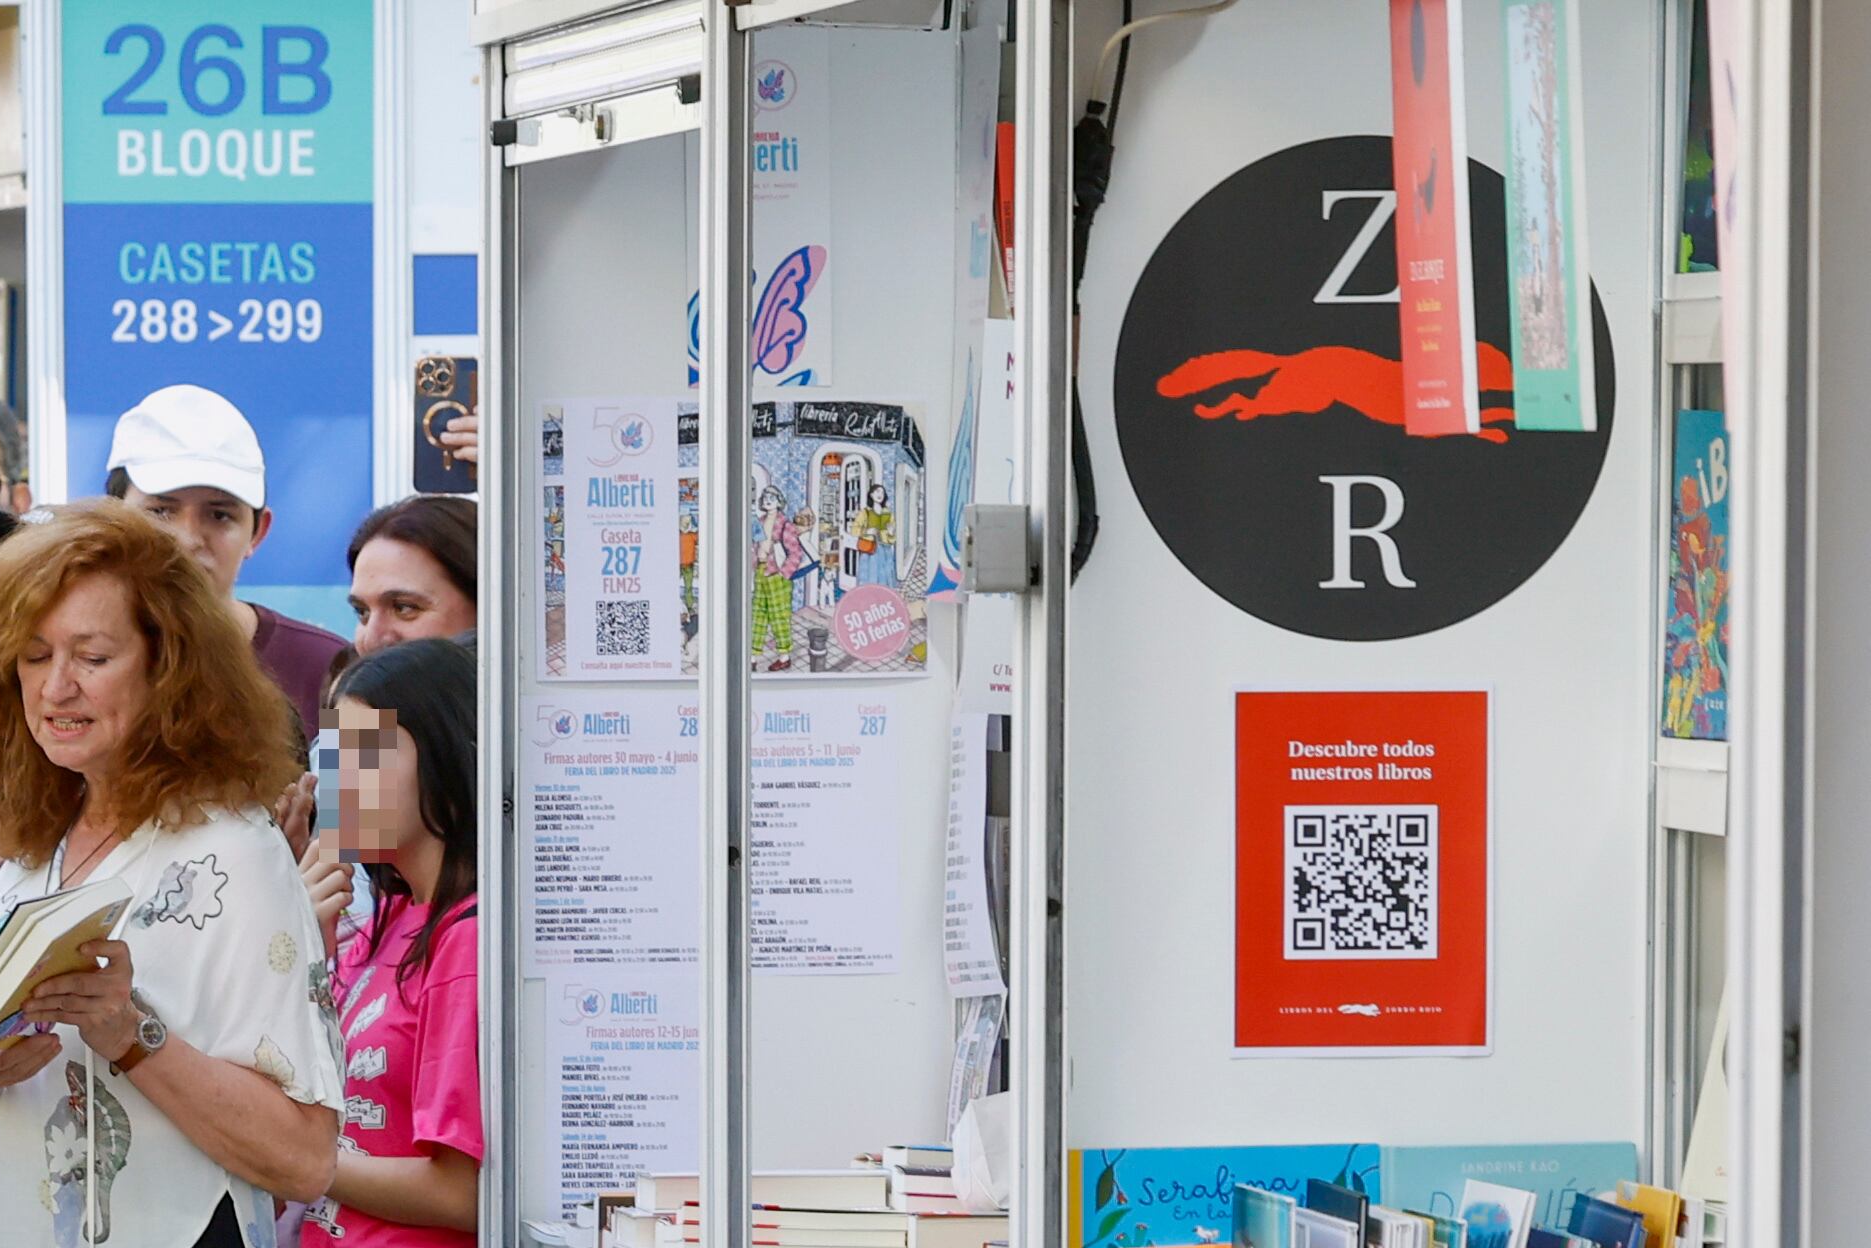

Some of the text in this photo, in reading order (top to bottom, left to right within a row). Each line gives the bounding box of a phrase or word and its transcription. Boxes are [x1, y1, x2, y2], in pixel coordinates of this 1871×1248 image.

[102, 24, 333, 117] 26B
[117, 130, 315, 179] BLOQUE
[119, 242, 315, 284] CASETAS
[587, 477, 655, 508] Alberti
[601, 528, 642, 545] Caseta
[1318, 475, 1417, 590] R
[601, 546, 642, 576] 287
[603, 577, 642, 594] FLM25
[843, 600, 896, 632] 50 años
[849, 616, 906, 652] 50 ferias
[677, 705, 699, 717] Case
[857, 704, 887, 715] Caseta
[583, 713, 631, 736] Alberti
[679, 717, 699, 737] 28
[764, 712, 811, 734] Alberti
[859, 716, 887, 736] 287
[544, 750, 699, 765] Firmas autores 30 mayo 4 junio
[770, 745, 805, 757] autores
[807, 744, 814, 756] 5
[836, 743, 862, 757] junio
[1288, 740, 1435, 758] Descubre todos
[565, 767, 584, 776] FERIA
[585, 766, 598, 776] DEL
[599, 766, 620, 776] LIBRO
[621, 766, 629, 776] DE
[631, 766, 658, 776] MADRID
[1291, 763, 1433, 780] nuestros libros
[610, 992, 658, 1014] Alberti
[586, 1025, 699, 1039] Firmas autores 12-15 jun
[591, 1041, 610, 1050] FERIA
[1461, 1160, 1560, 1175] SANDRINE KAO
[1173, 1207, 1199, 1221] En
